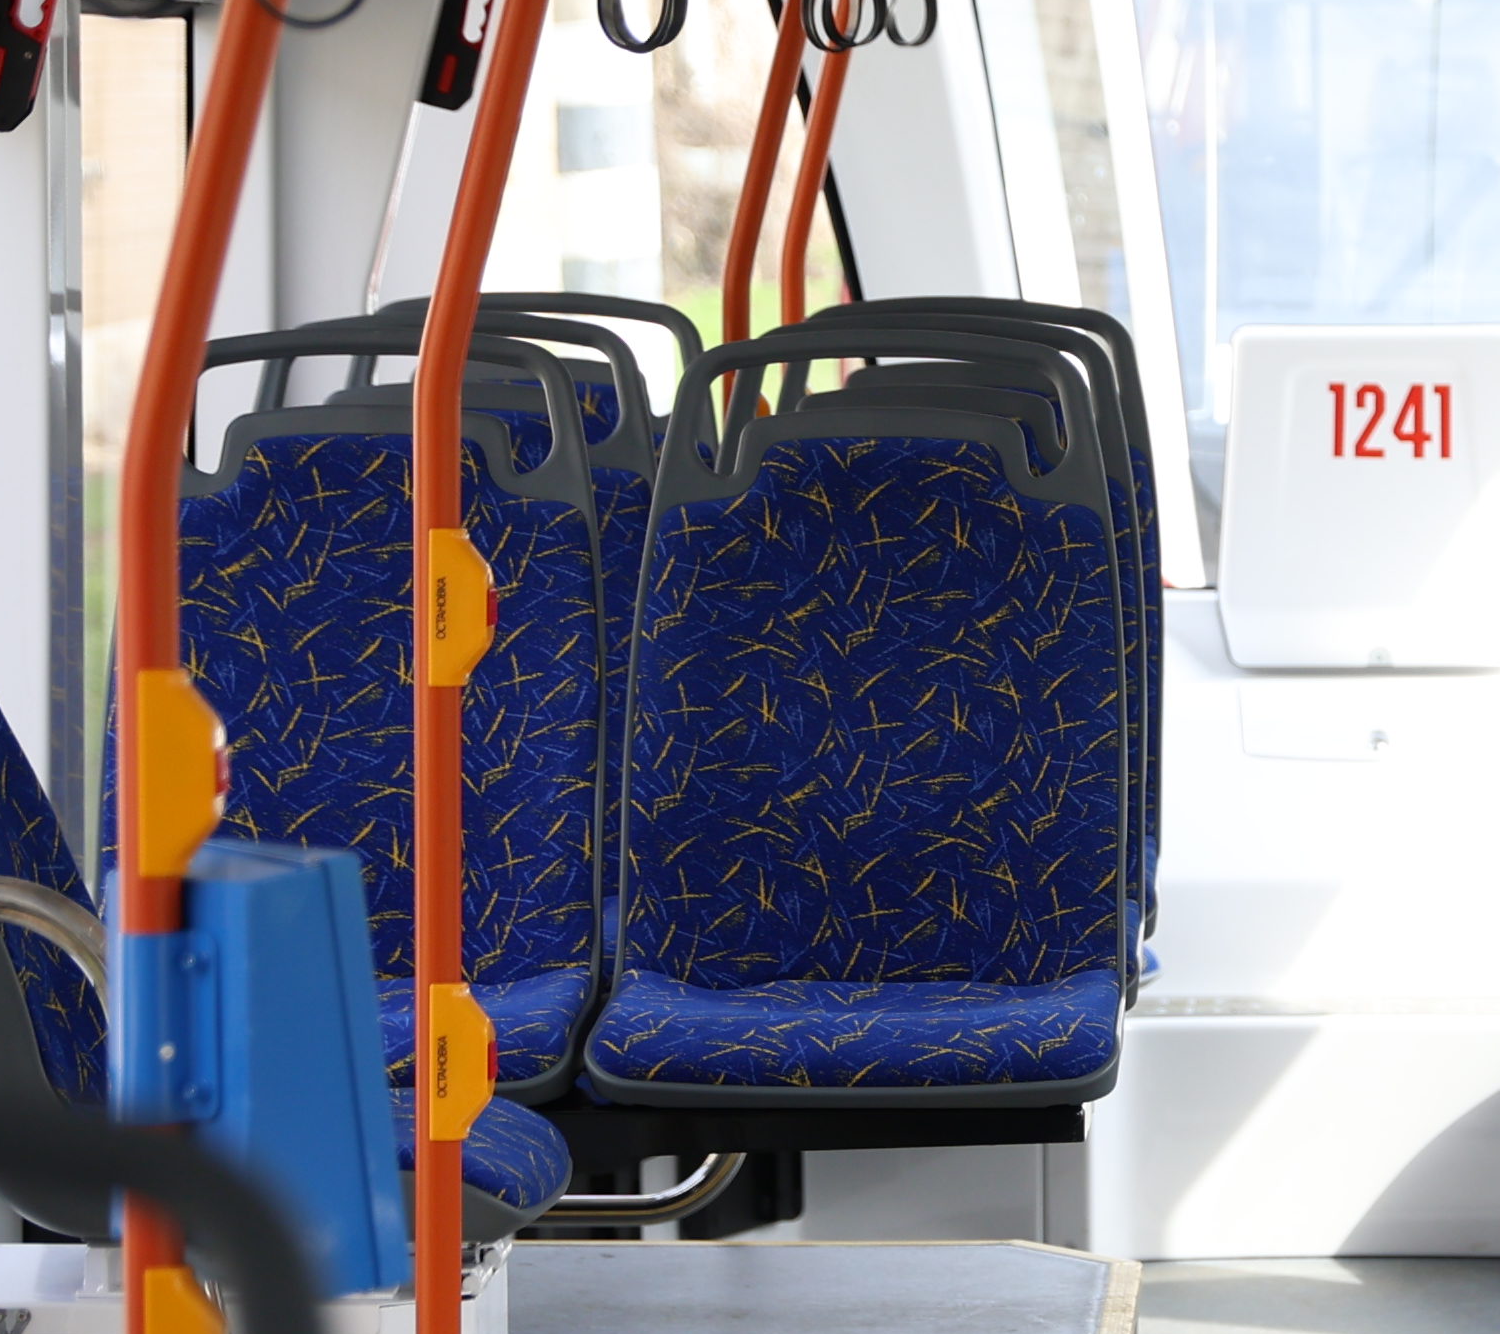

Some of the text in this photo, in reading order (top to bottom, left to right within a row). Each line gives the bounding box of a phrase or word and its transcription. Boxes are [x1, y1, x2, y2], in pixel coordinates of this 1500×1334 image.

[1328, 381, 1452, 459] 1241
[435, 576, 447, 640] ОСТАНОВКА
[436, 1035, 448, 1099] ОСТАНОВКА
